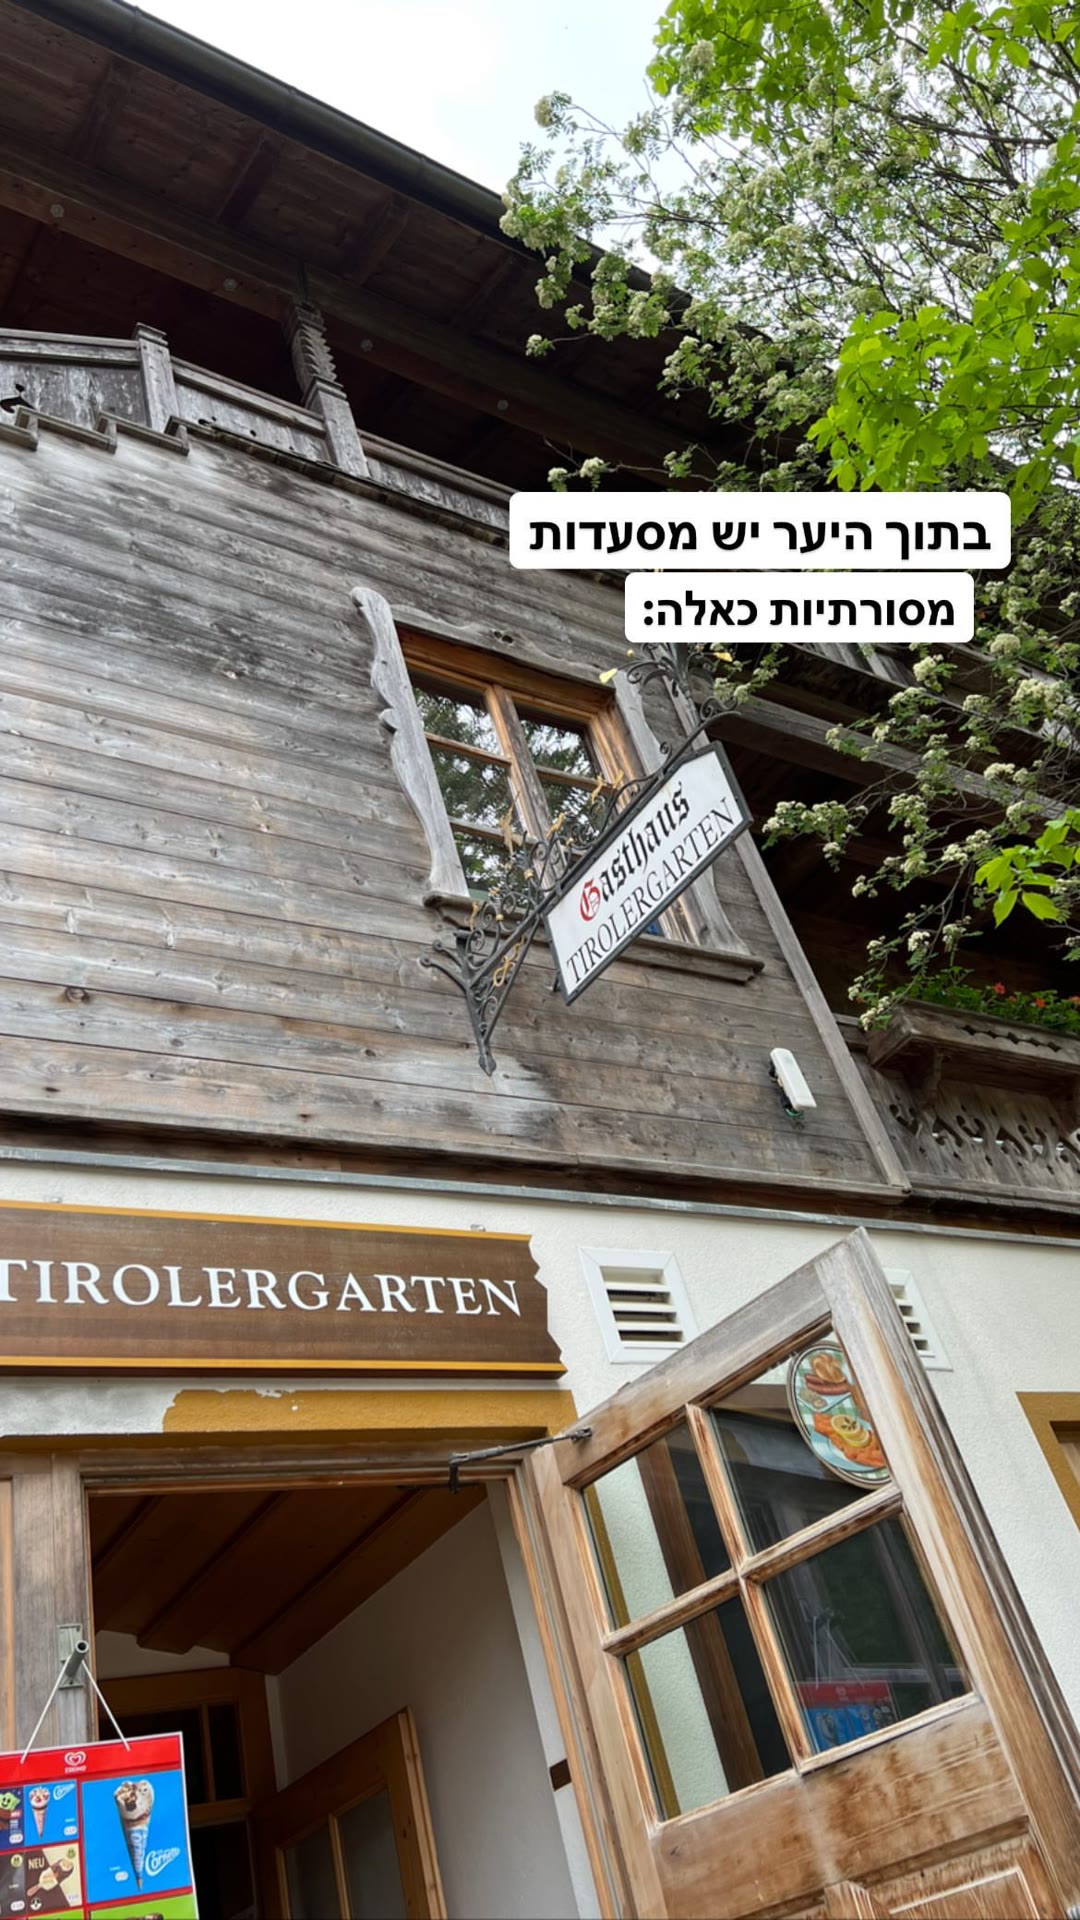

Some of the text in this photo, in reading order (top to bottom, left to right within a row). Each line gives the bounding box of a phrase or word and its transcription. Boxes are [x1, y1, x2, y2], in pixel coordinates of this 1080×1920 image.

[566, 796, 736, 984] TIROLERGARTEN
[578, 781, 691, 922] Gasthaus
[0, 1257, 522, 1318] TIROLERGARTEN
[28, 1857, 45, 1870] NEU
